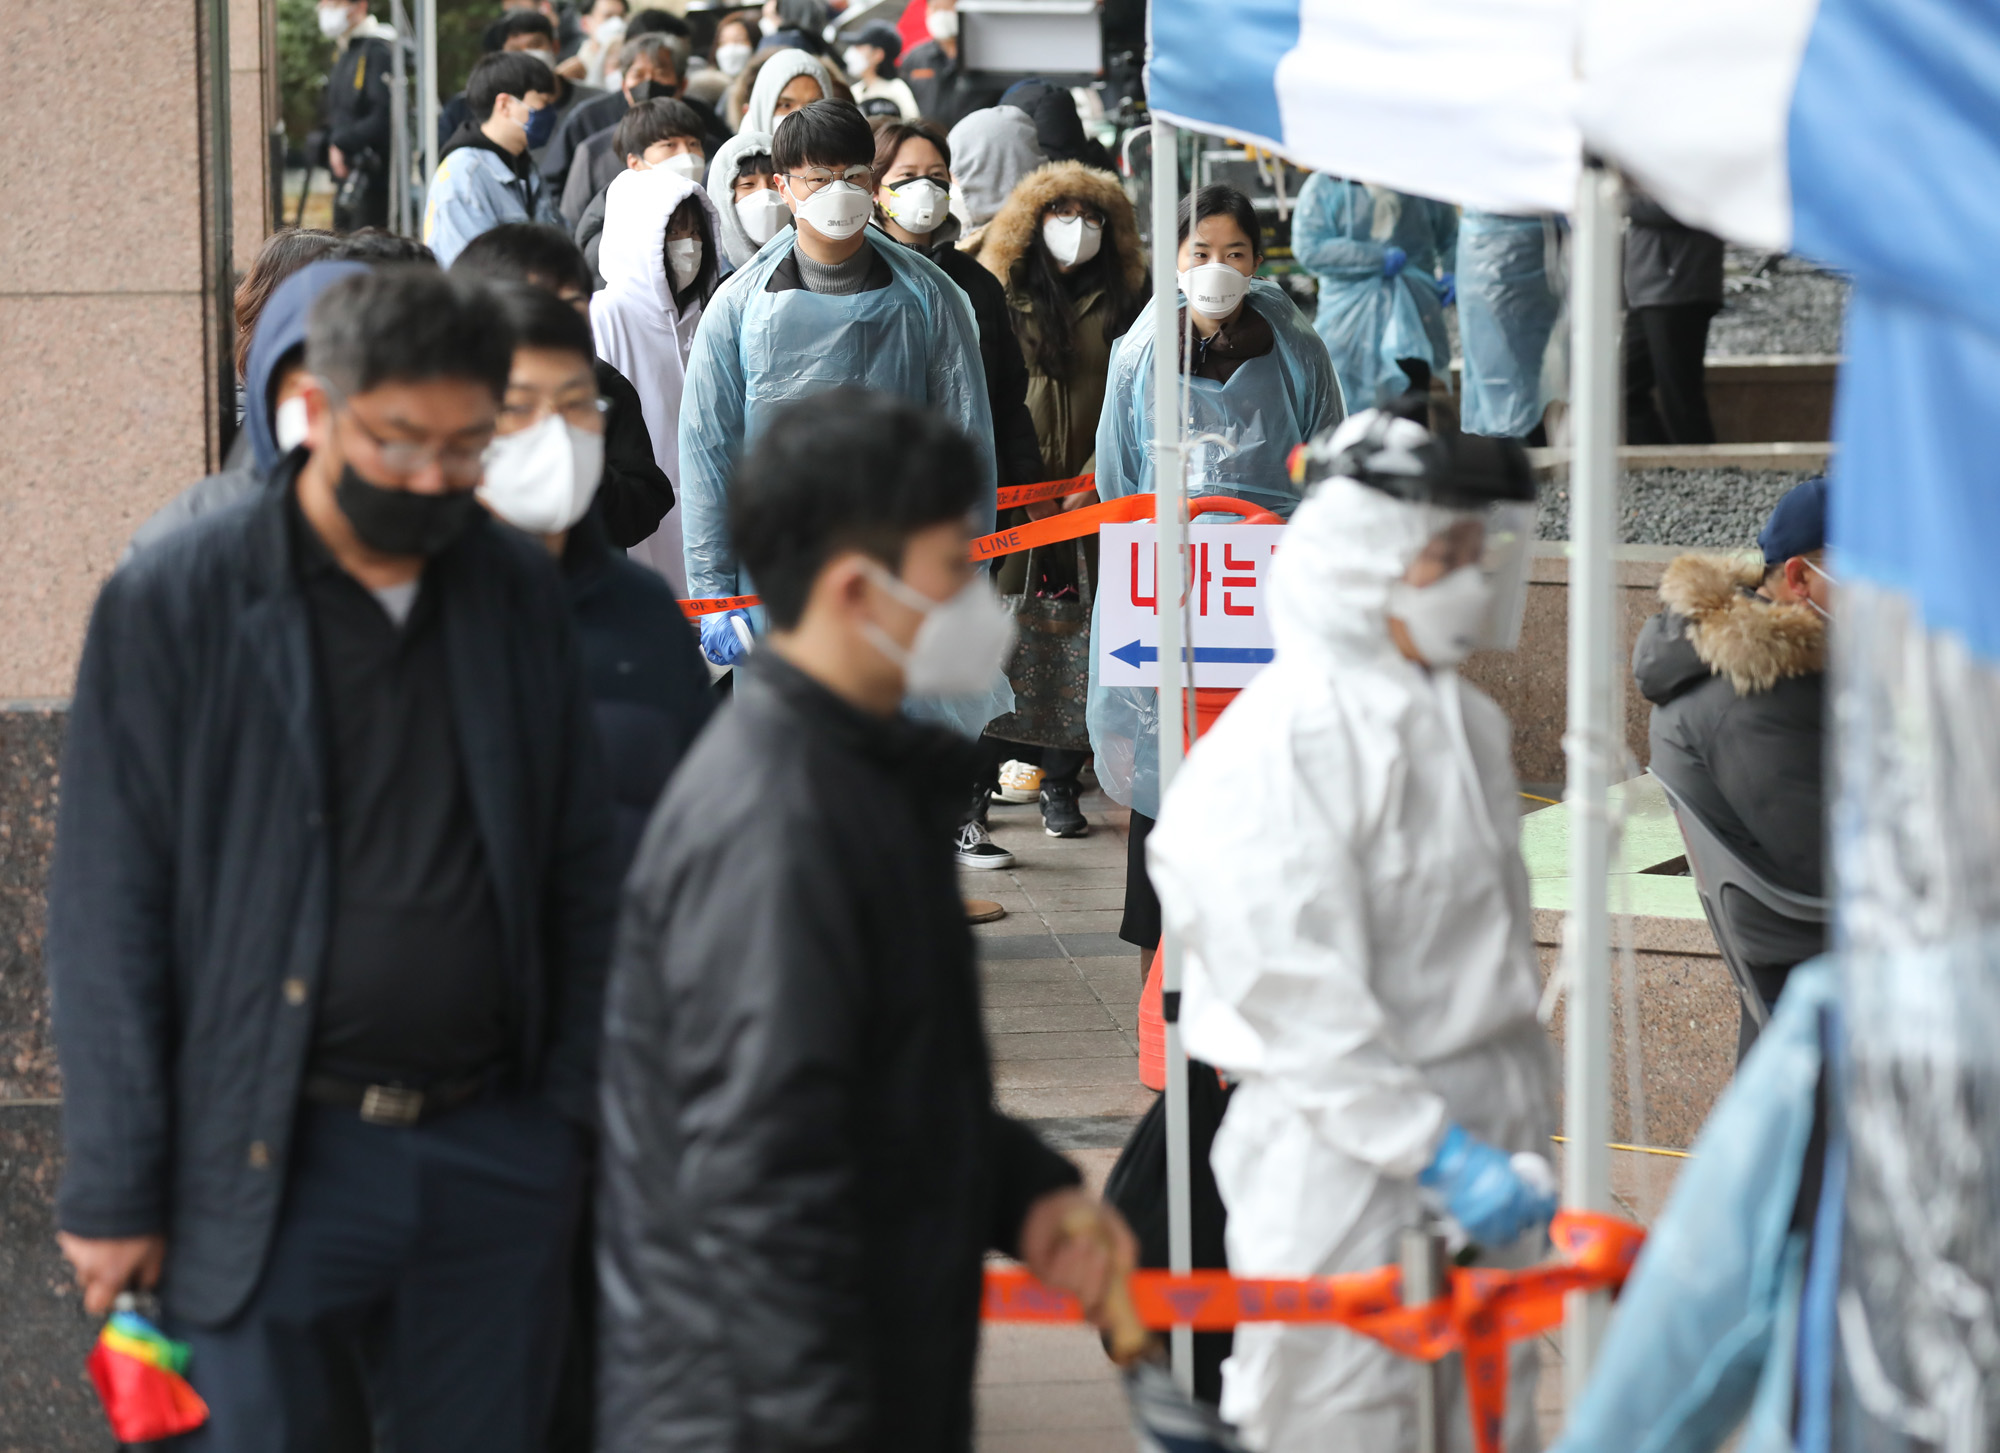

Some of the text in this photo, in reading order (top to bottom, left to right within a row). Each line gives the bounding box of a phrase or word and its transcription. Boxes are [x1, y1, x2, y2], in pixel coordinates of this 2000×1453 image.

[827, 219, 840, 227] 3M
[1198, 294, 1211, 303] 3M
[978, 532, 1021, 554] LINE
[1130, 542, 1257, 616] 나가는
